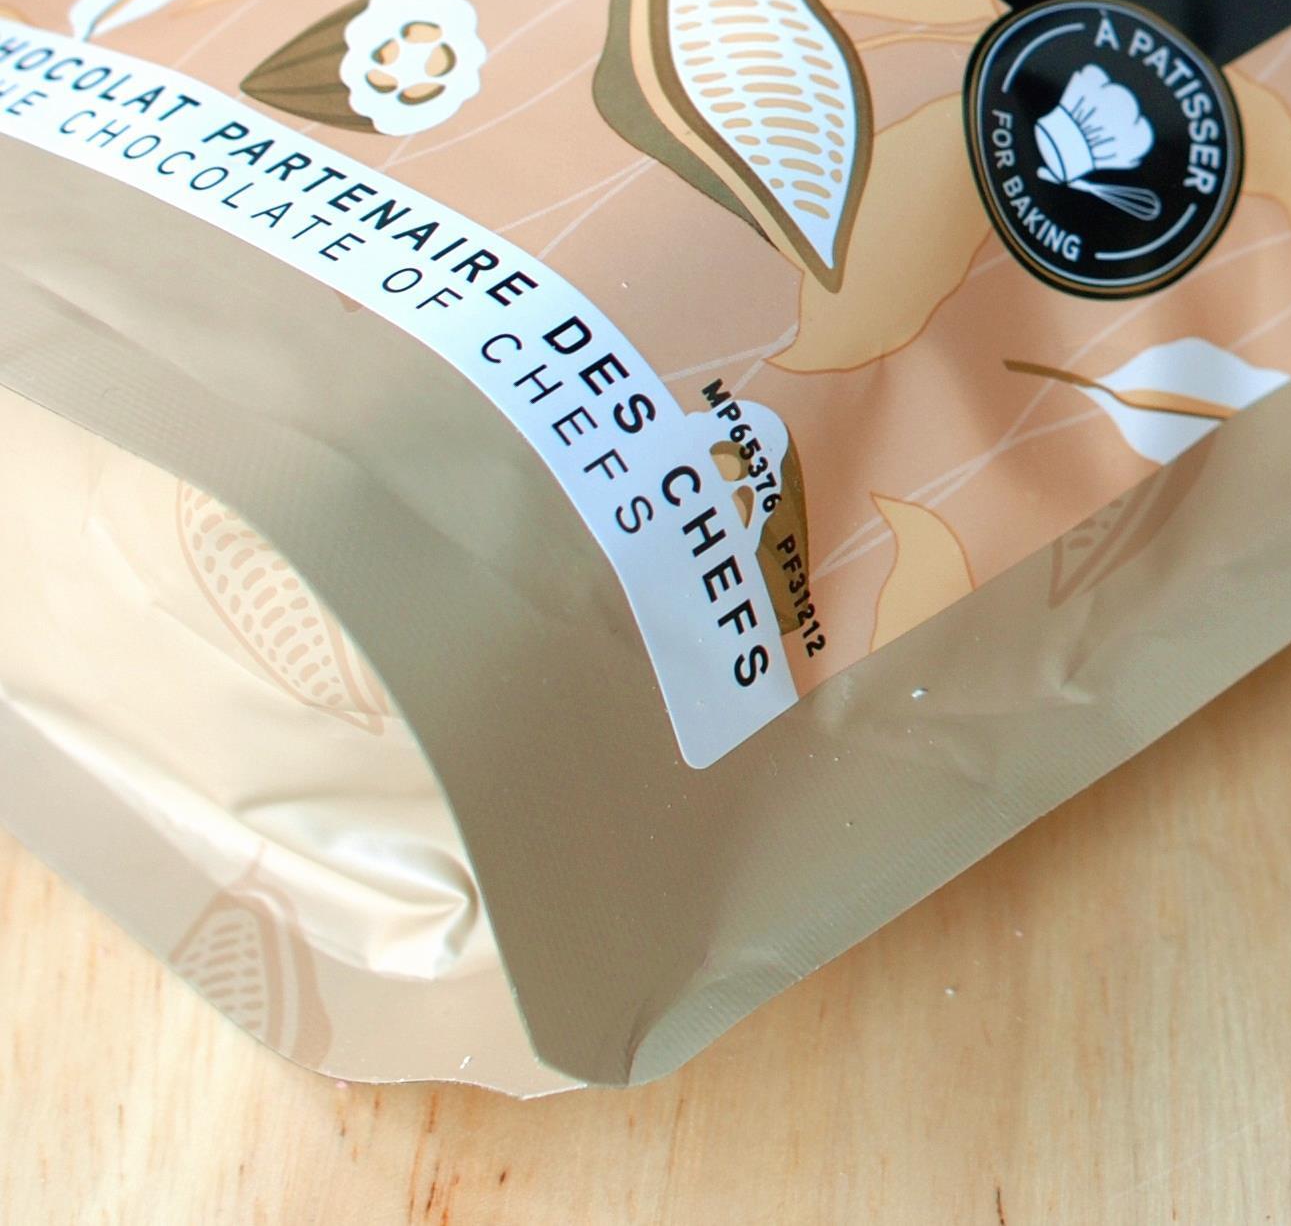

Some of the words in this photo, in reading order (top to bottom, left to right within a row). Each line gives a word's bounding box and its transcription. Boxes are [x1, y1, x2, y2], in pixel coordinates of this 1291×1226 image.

[992, 109, 1015, 168] FOR
[1128, 30, 1219, 194] PATISSER
[1003, 176, 1081, 262] BAKING
[58, 109, 365, 261] CHOCOLATE
[380, 266, 463, 311] OF
[480, 332, 656, 535] CHEFS
[201, 121, 539, 307] PARTENAIRE
[541, 314, 656, 434] DES
[661, 464, 770, 688] CHEFS
[700, 377, 783, 513] MP65376
[775, 533, 827, 658] PF31212
